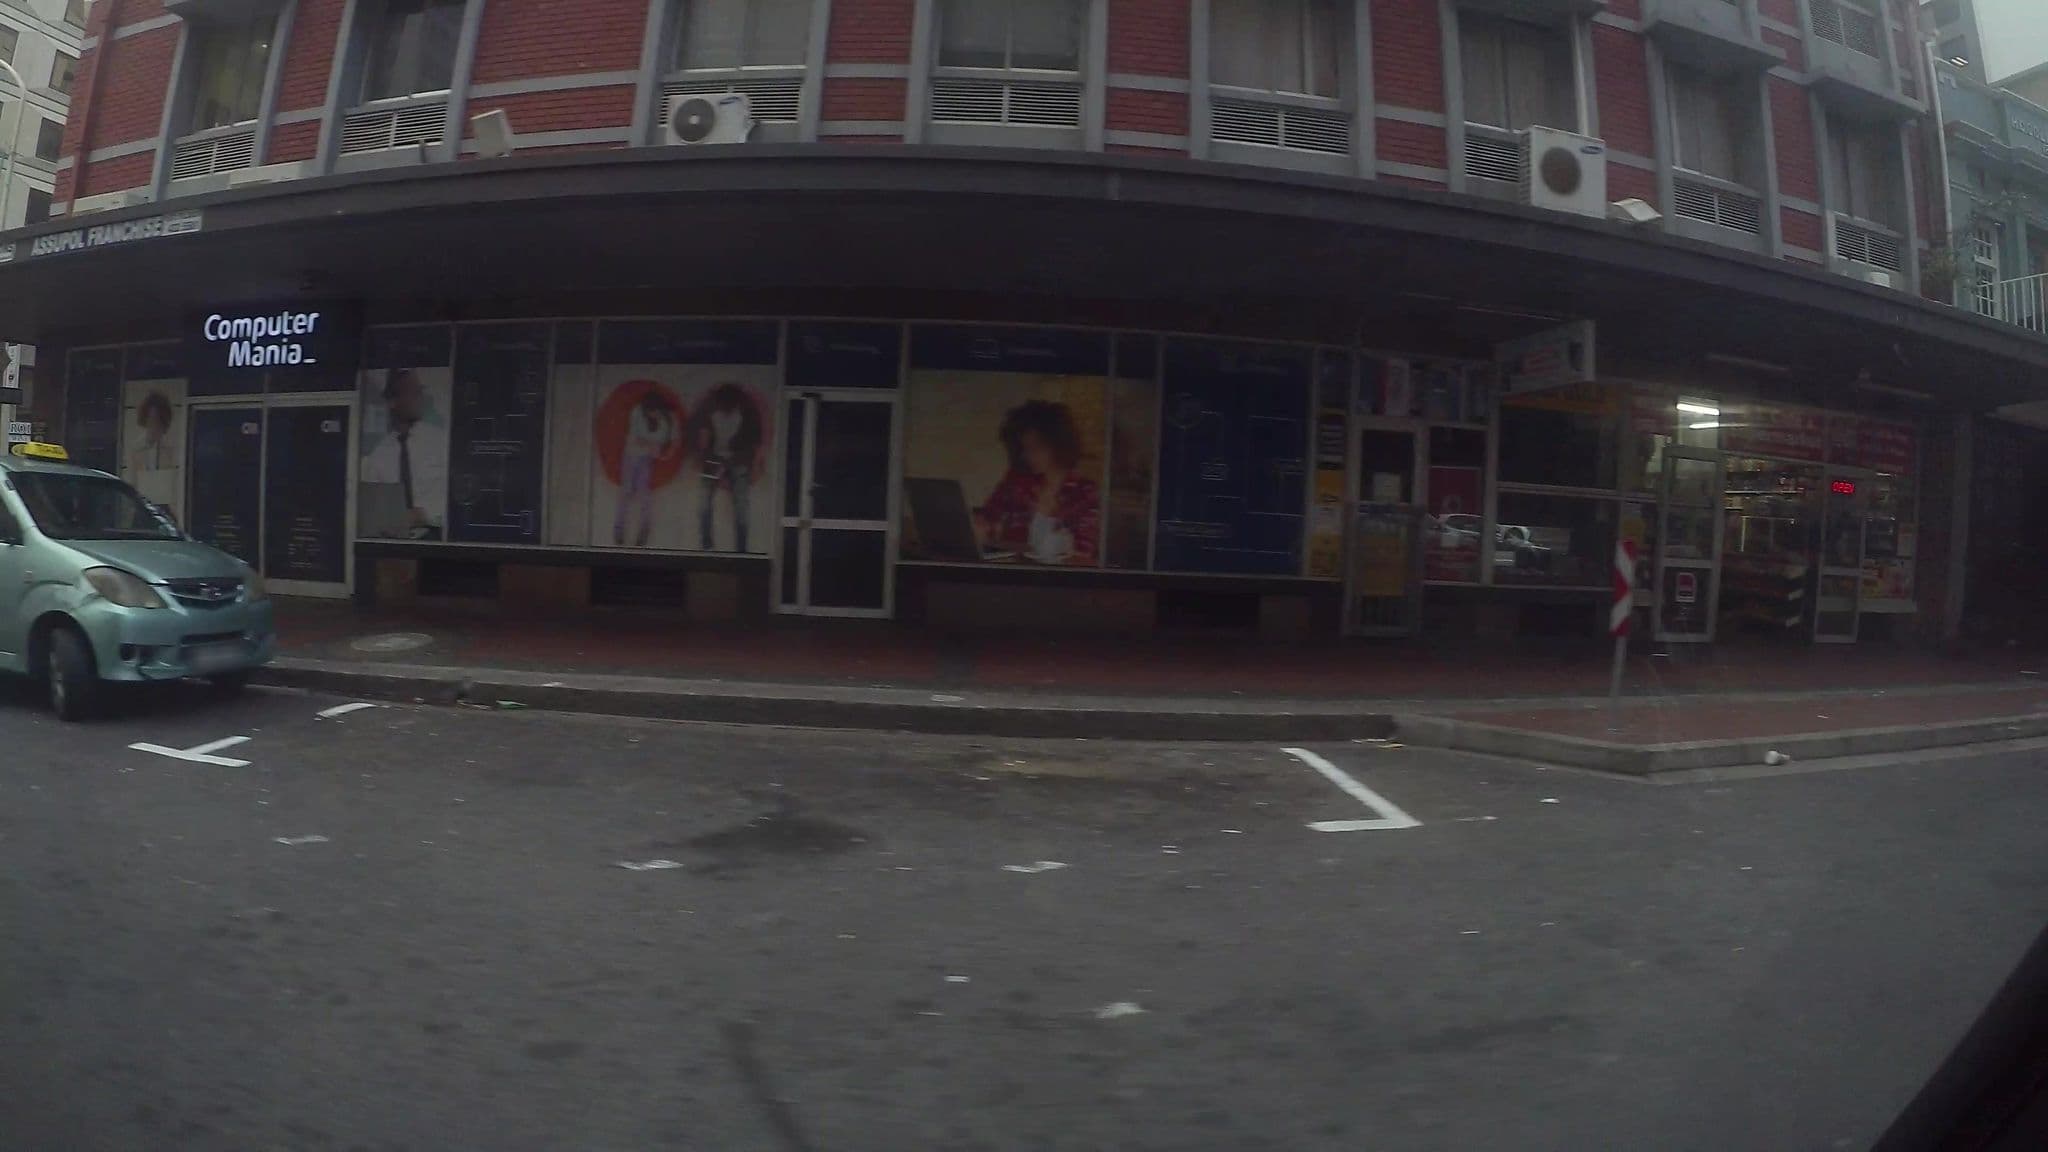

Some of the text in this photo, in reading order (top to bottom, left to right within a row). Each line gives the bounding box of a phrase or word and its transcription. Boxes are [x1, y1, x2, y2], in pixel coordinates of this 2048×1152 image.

[31, 229, 85, 256] ASSUPOL
[87, 215, 163, 246] FRANCHISE
[204, 311, 320, 344] Computer
